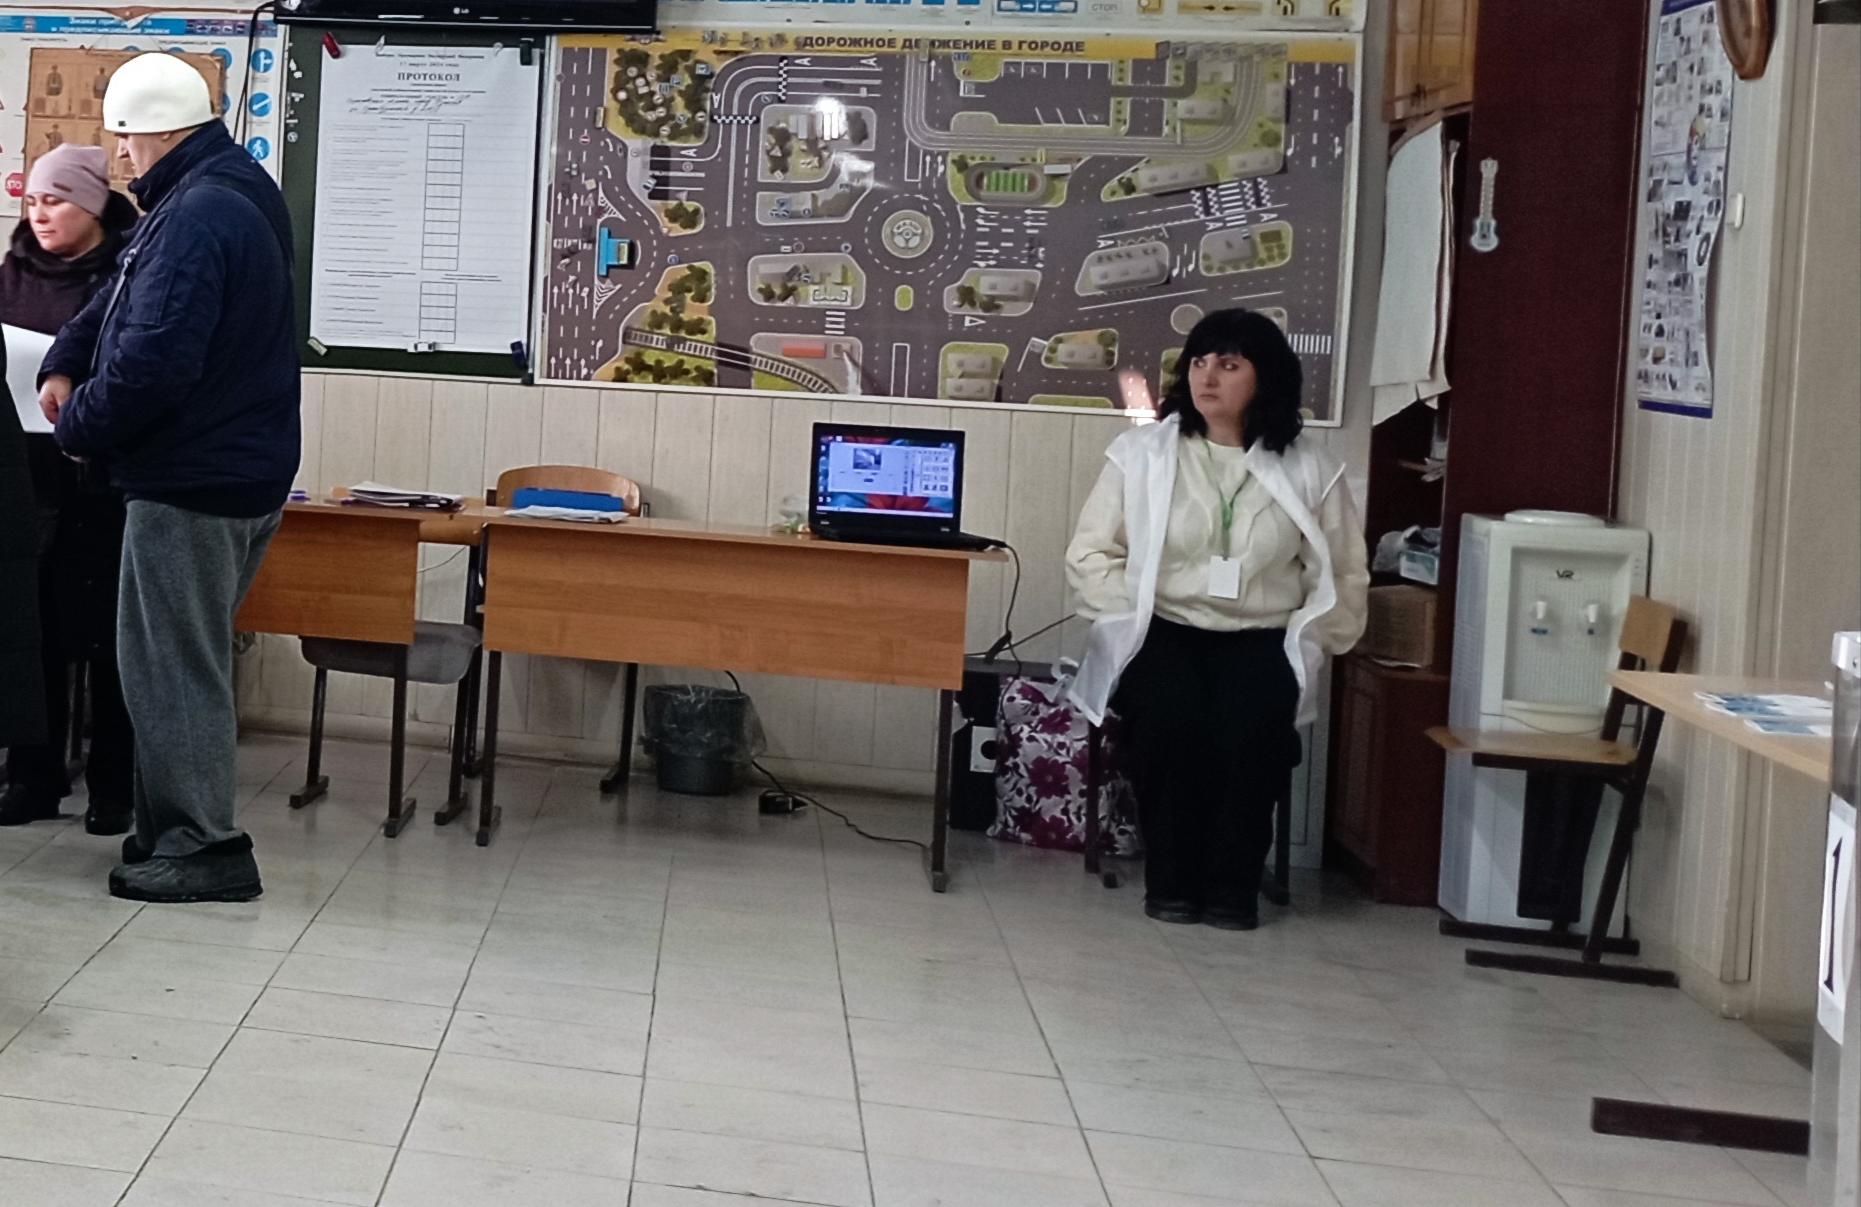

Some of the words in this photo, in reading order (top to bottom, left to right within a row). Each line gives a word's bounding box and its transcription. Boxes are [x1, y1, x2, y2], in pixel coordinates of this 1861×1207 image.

[802, 36, 897, 48] ДОРОЖНОЕ
[1002, 41, 1012, 50] В
[1018, 41, 1085, 53] ГОРОДЕ
[397, 72, 460, 82] ПРОТОКОЛ
